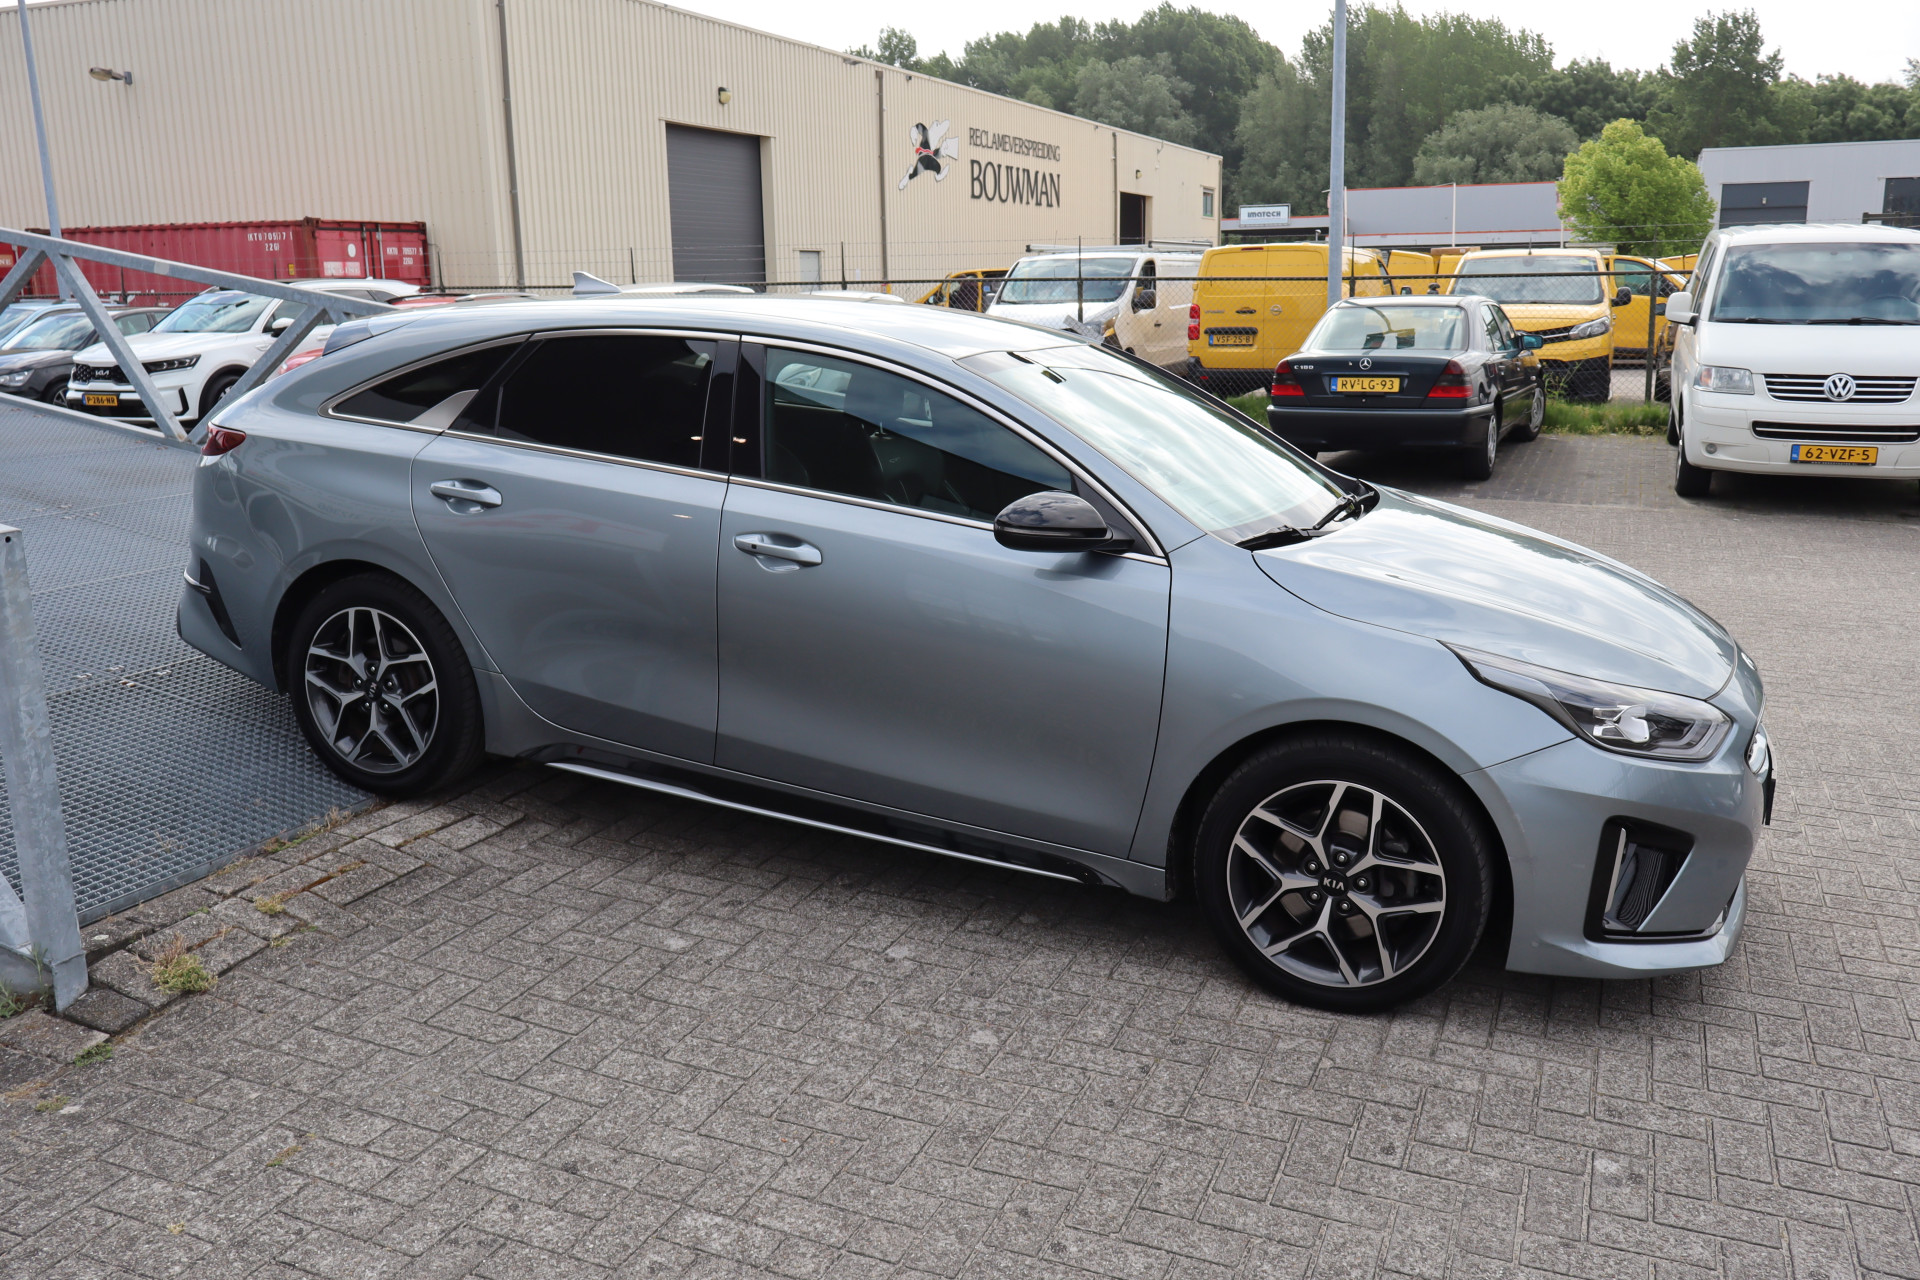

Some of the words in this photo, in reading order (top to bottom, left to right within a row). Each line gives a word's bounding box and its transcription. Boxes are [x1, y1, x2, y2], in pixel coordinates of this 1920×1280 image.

[968, 127, 1060, 162] RECLAMEVERSPREIDING
[970, 159, 1060, 208] BOUWMAN
[1341, 379, 1394, 390] RV-LG-93
[1805, 447, 1870, 461] 62-VZF-5
[1322, 877, 1345, 891] KIA
